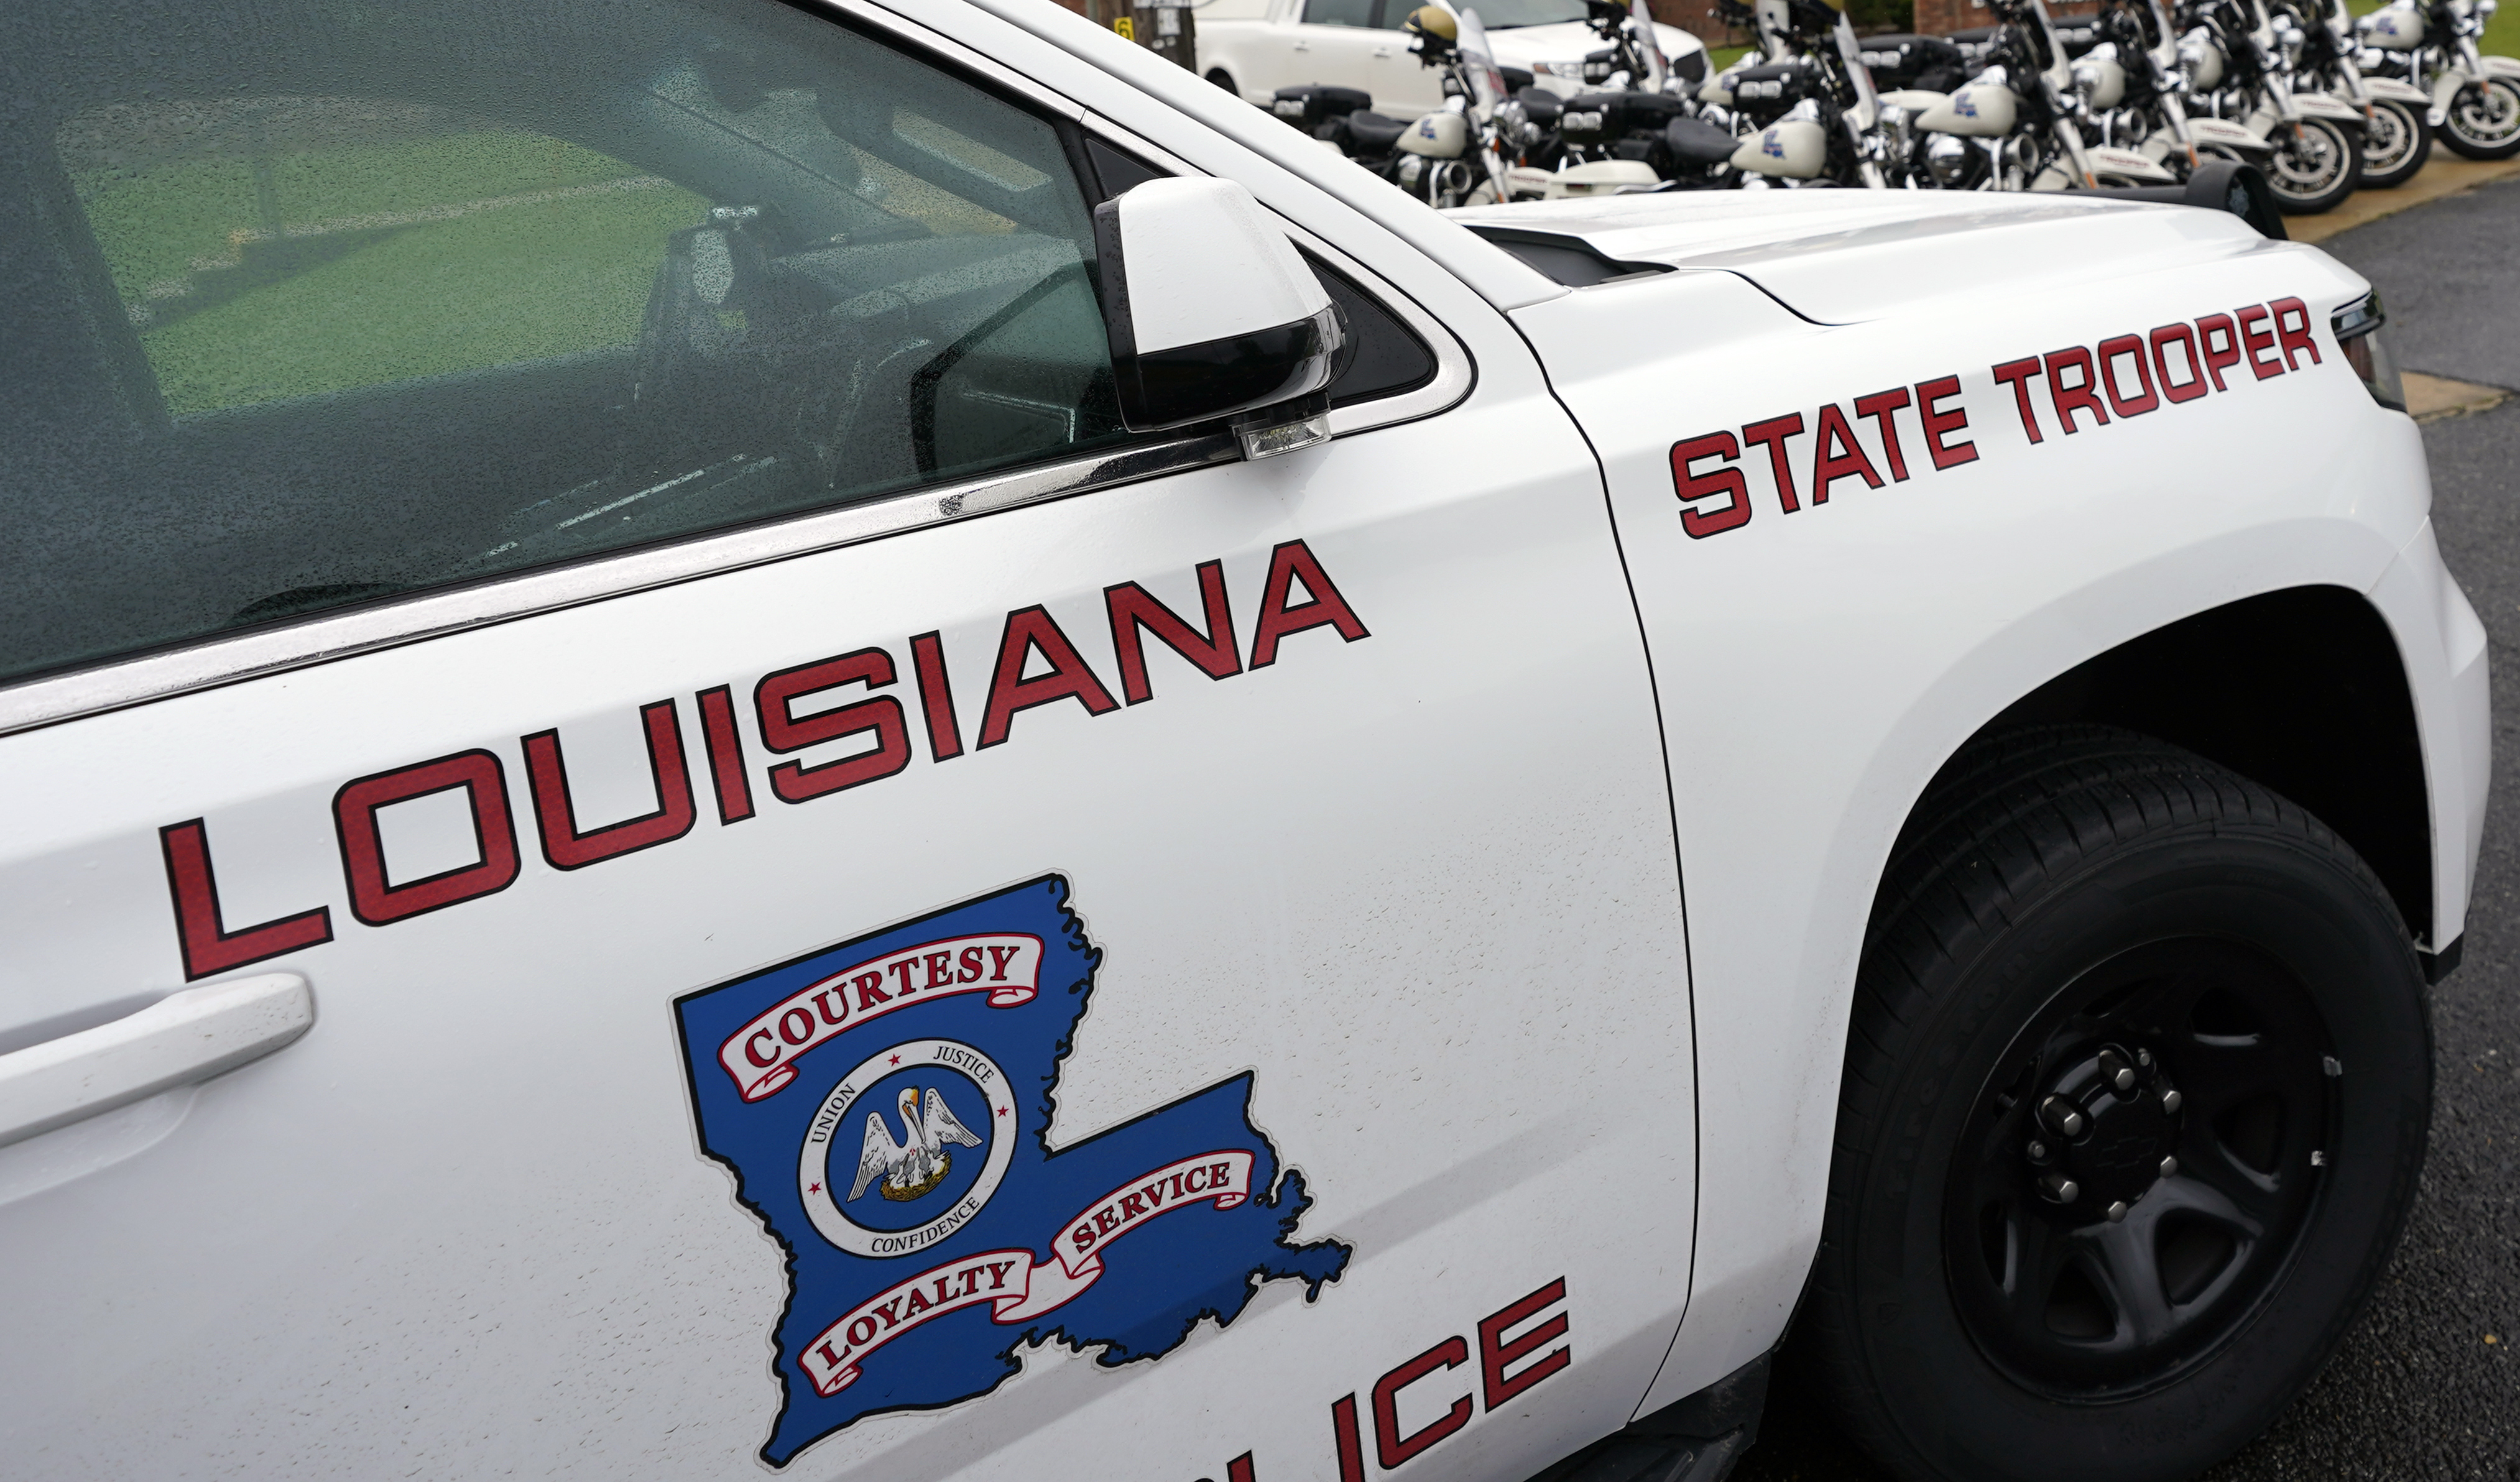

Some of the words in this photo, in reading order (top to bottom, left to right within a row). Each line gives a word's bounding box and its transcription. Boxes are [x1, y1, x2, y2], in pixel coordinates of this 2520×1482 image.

[1669, 374, 1980, 540] STATE
[1991, 296, 2323, 445] TROOPER
[159, 538, 1372, 983] LOUISIANA
[744, 946, 1020, 1068] COURTESY
[810, 1082, 857, 1144] UNION
[933, 1046, 994, 1084] JUSTICE
[870, 1197, 980, 1253] CONFIDENCE
[1072, 1161, 1230, 1254] SERVICE
[815, 1260, 1016, 1371] LOYALTY
[1193, 1275, 1571, 1482] ICE
